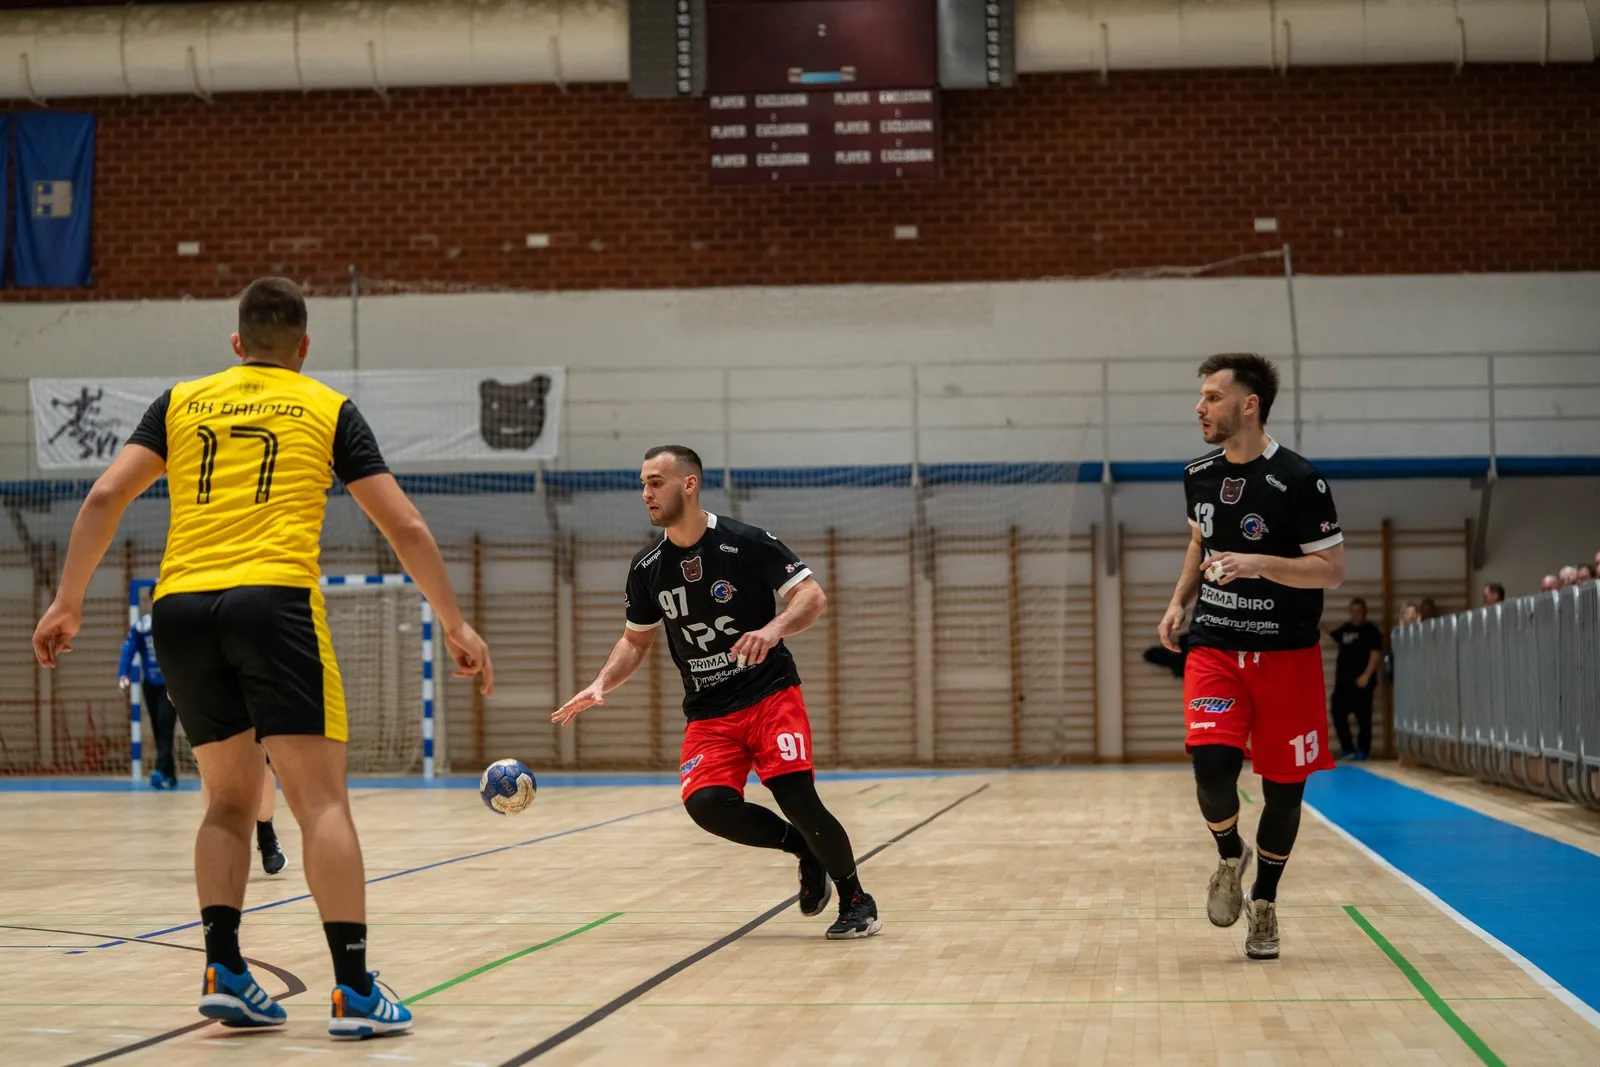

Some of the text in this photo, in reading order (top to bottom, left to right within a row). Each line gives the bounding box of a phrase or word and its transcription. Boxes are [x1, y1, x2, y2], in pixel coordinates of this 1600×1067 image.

[710, 93, 809, 109] PLAYER EXCLUSION
[833, 89, 932, 105] PLAYER EXCLUSION
[710, 123, 809, 139] PLAYER EXCLUSION
[834, 119, 934, 134] PLAYER EXCLUSION
[711, 152, 810, 168] PLAYER EXCLUSION
[835, 148, 934, 164] PLAYER EXCLUSION
[197, 425, 278, 504] 17
[1188, 460, 1214, 475] Kempa
[1194, 502, 1215, 538] 13
[641, 549, 662, 569] Kempa
[658, 586, 689, 619] 97
[1238, 597, 1275, 610] BIRO
[690, 656, 726, 670] PRIMA
[776, 731, 807, 761] 97
[1289, 730, 1319, 767] 13
